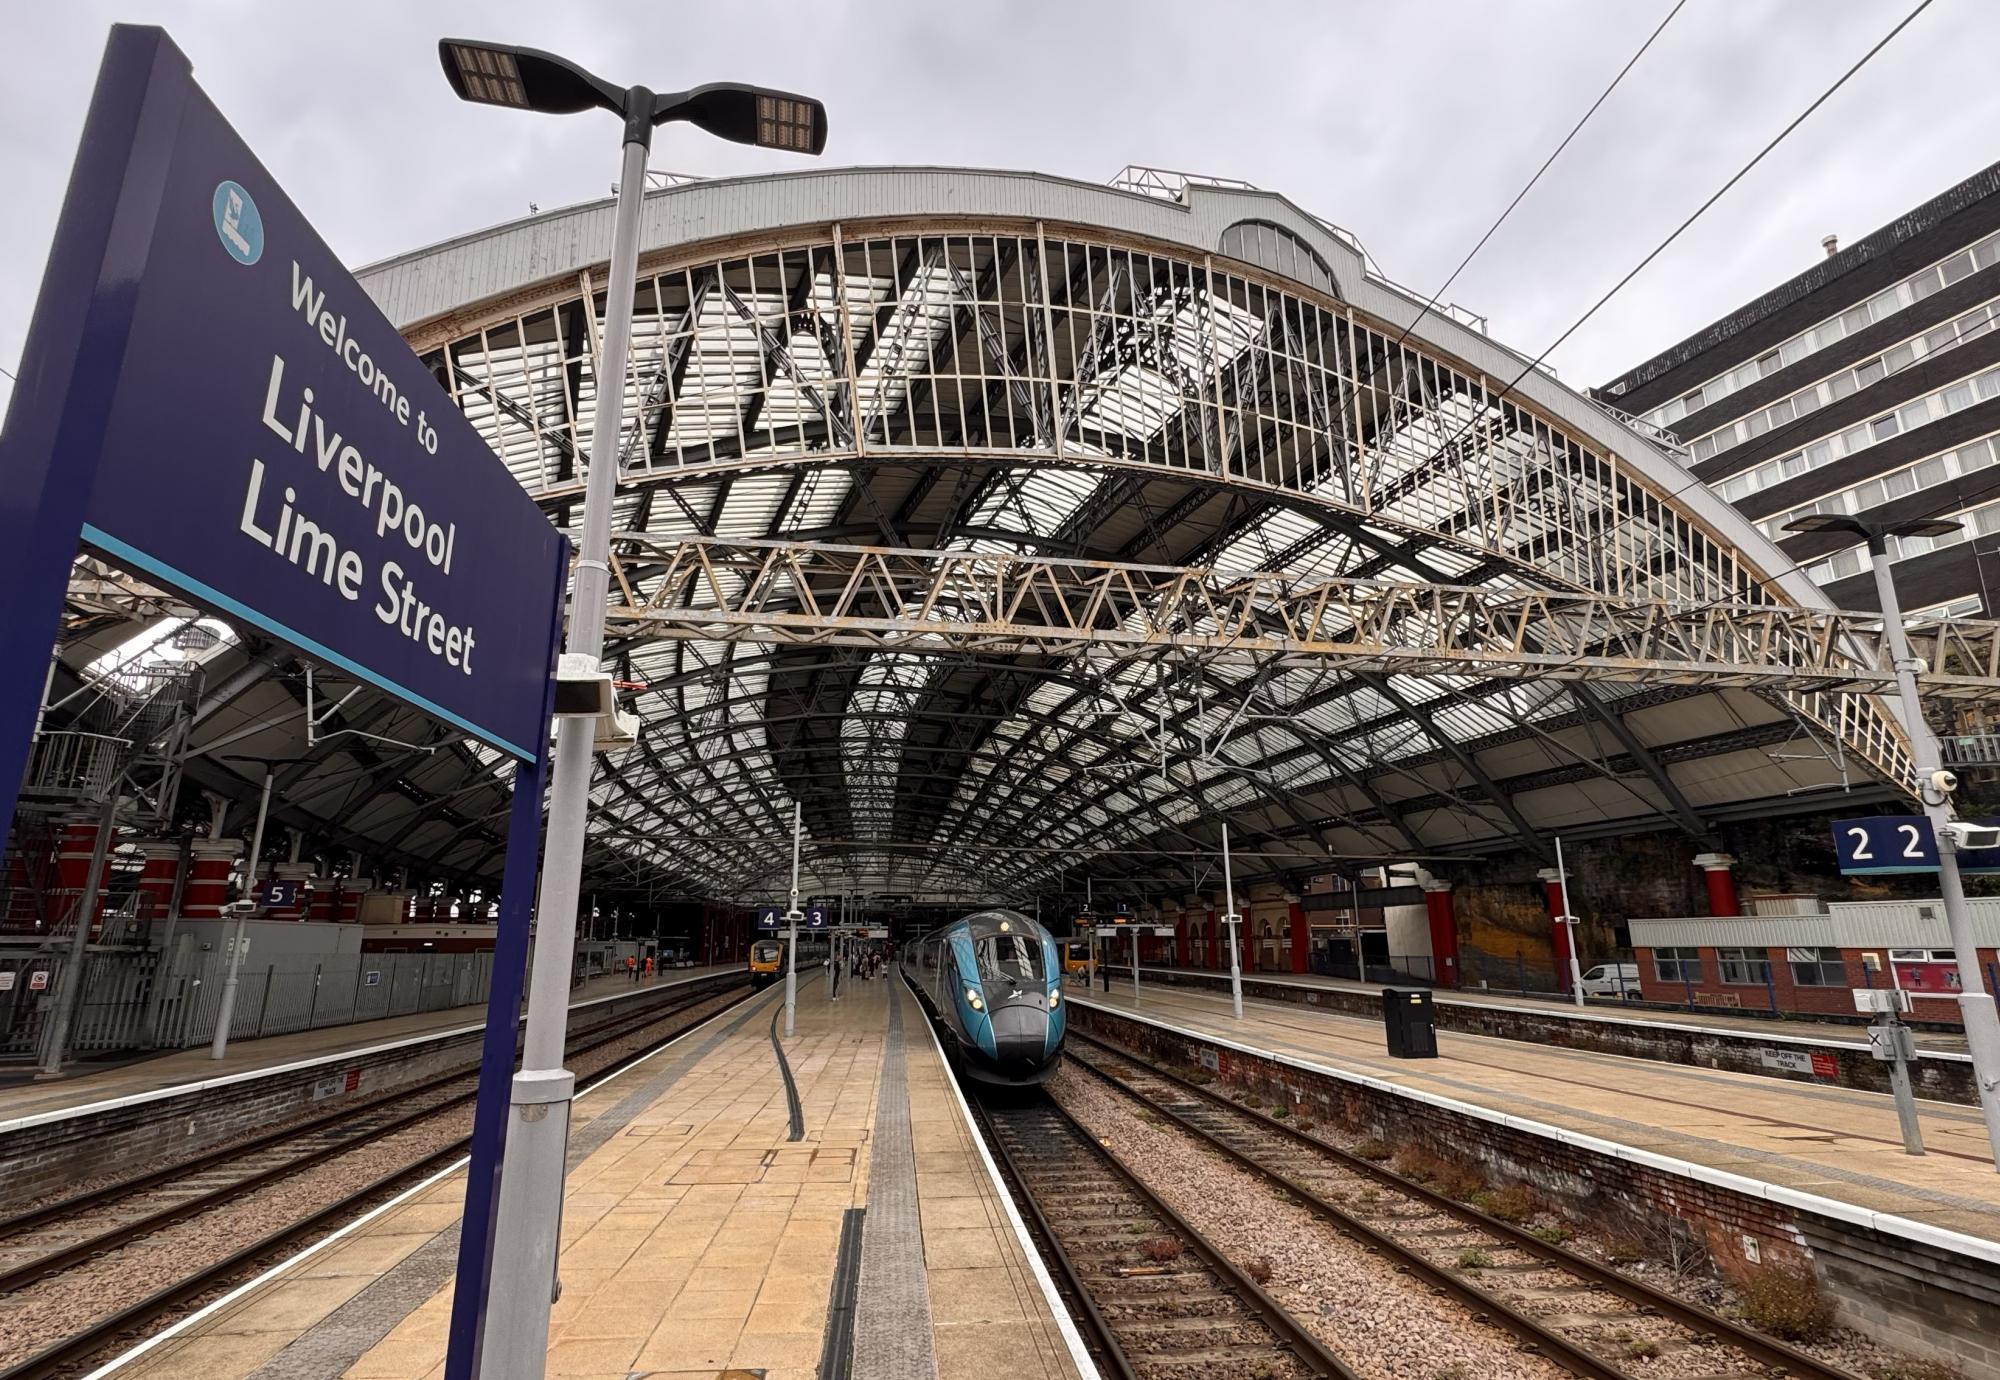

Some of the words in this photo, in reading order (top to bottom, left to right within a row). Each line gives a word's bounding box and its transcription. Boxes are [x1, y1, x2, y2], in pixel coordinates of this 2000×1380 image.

[292, 260, 410, 426] Welcome
[417, 410, 438, 455] to
[262, 354, 455, 575] Liverpool
[240, 458, 363, 601] Lime
[374, 560, 475, 675] Street
[1848, 827, 1873, 860] 2
[1897, 824, 1925, 858] 2
[270, 886, 284, 903] 5
[1083, 903, 1089, 912] 2
[1122, 903, 1127, 912] 1
[763, 911, 775, 926] 4
[812, 911, 822, 926] 3
[1765, 1050, 1780, 1058] KEEP
[1781, 1052, 1793, 1060] OFF
[1794, 1054, 1806, 1062] THE
[1776, 1059, 1797, 1069] TRACK
